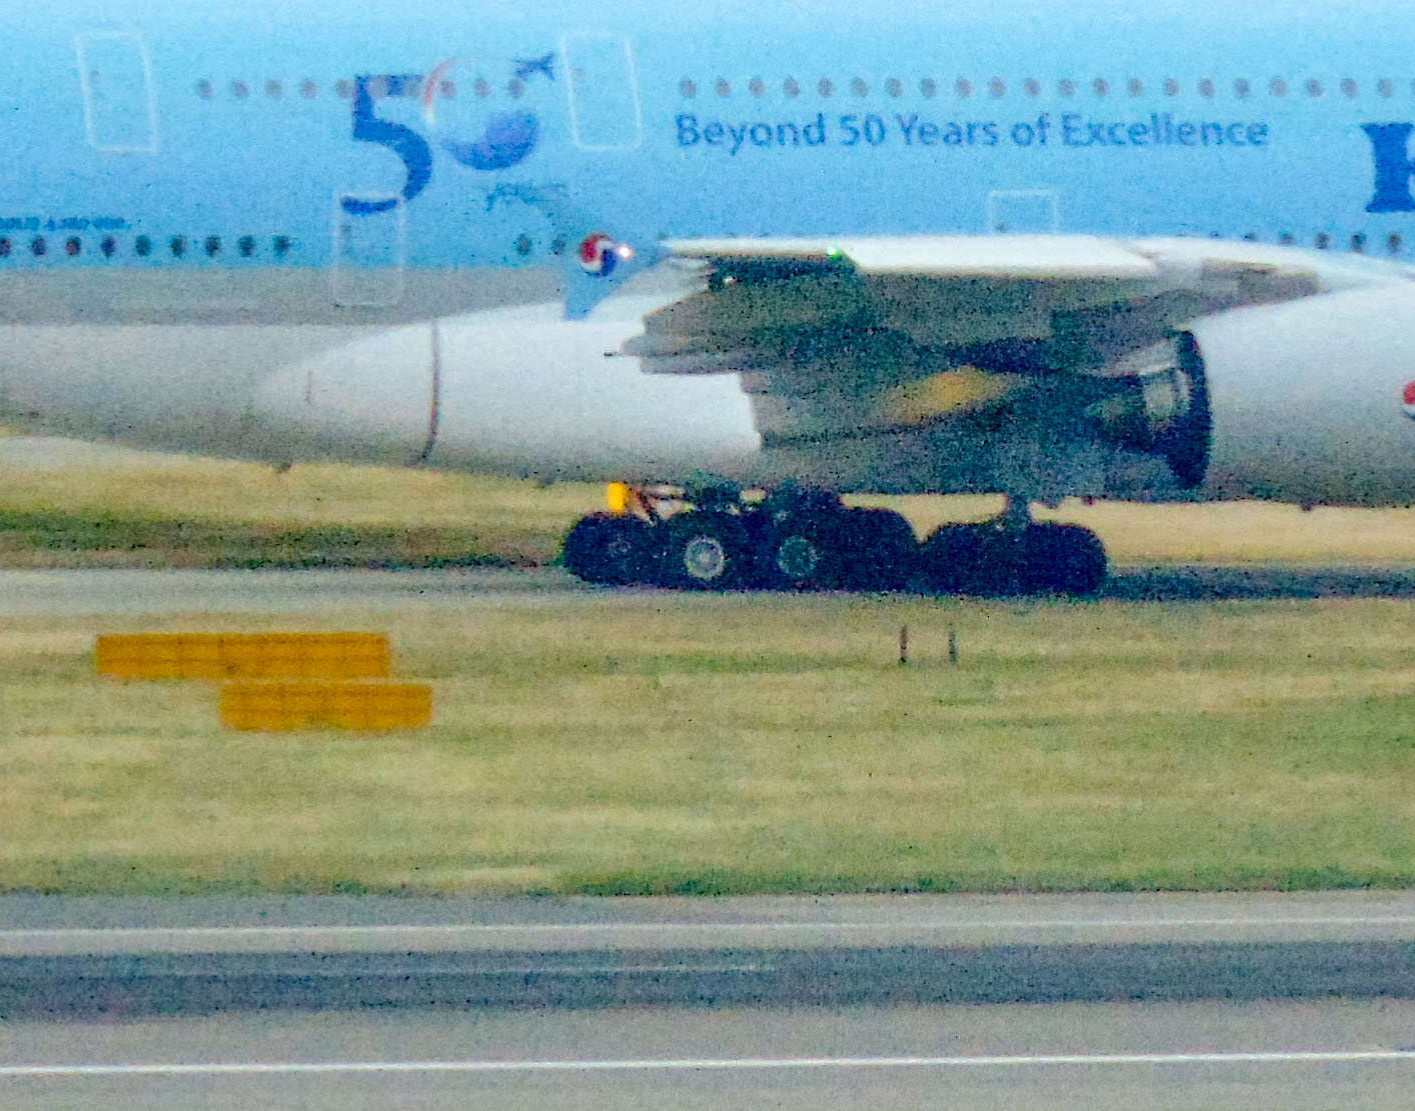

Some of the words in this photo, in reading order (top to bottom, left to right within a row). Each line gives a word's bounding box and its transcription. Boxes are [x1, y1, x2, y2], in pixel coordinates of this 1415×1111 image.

[675, 112, 826, 156] Beyond
[840, 114, 885, 146] 50
[894, 113, 999, 146] Years
[1011, 112, 1051, 147] of
[1061, 112, 1270, 147] Excellence
